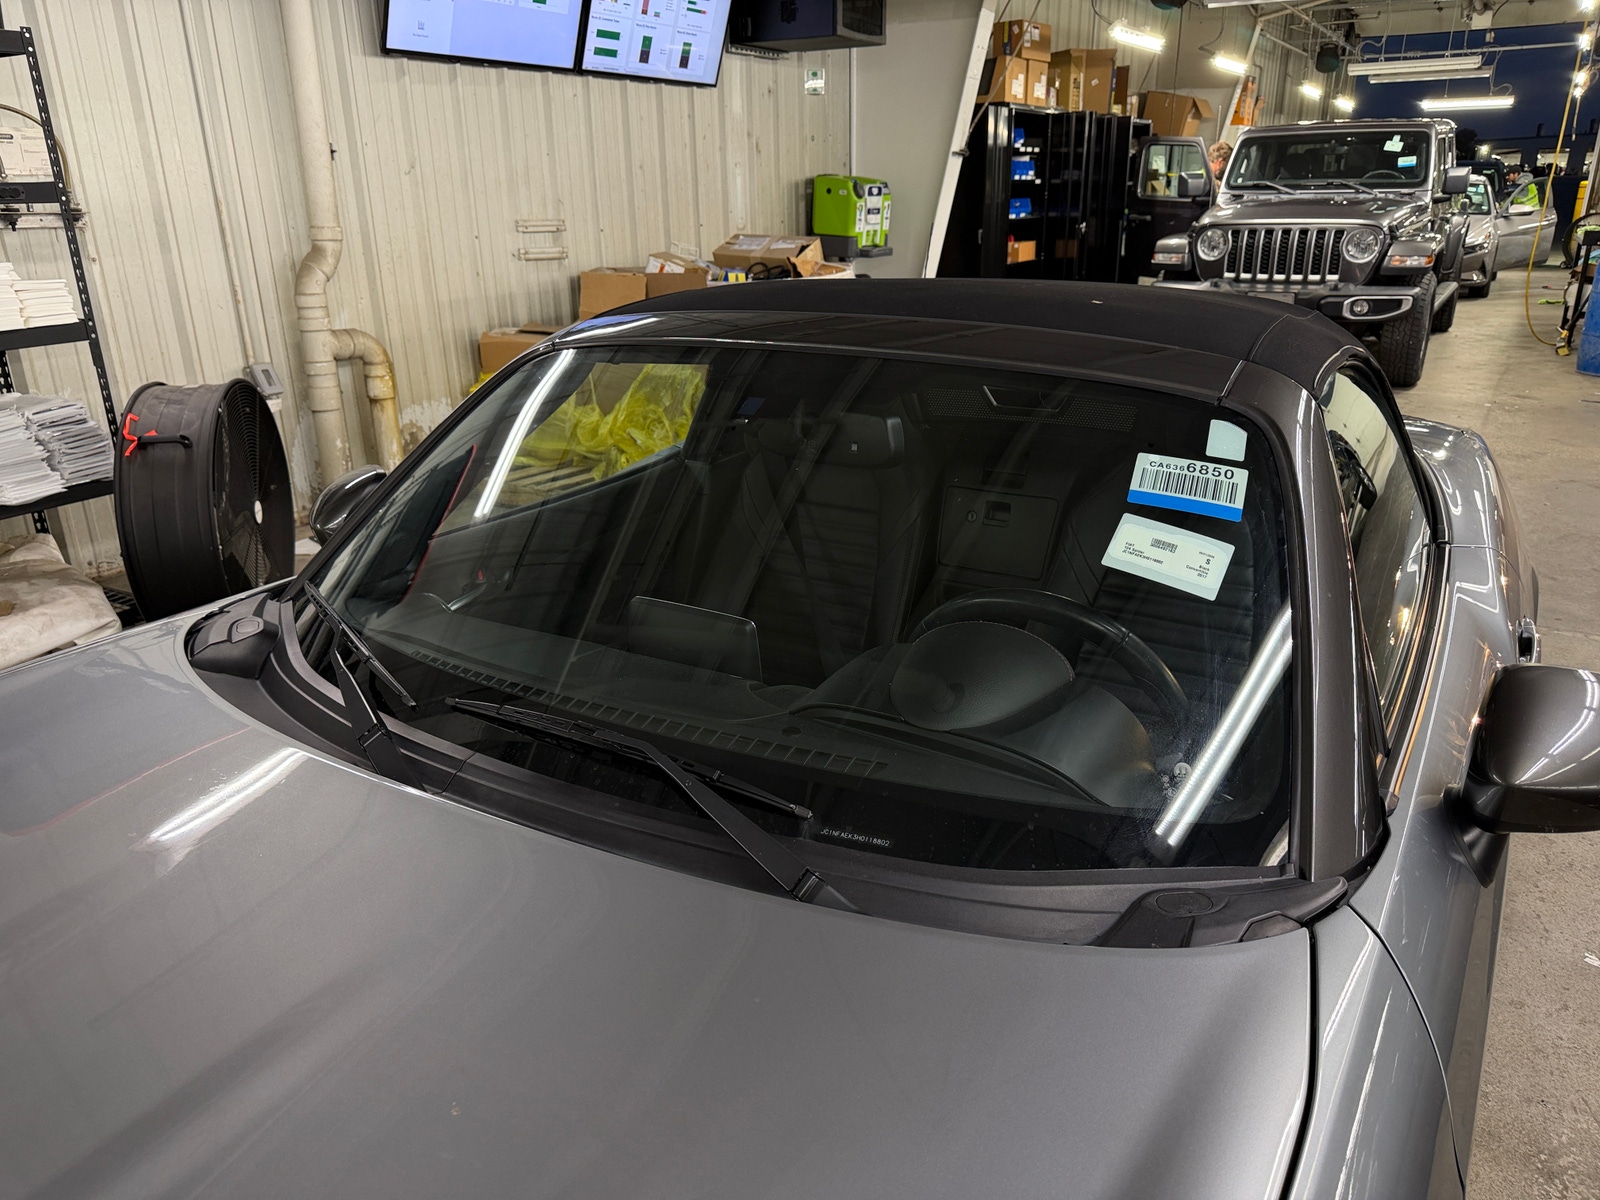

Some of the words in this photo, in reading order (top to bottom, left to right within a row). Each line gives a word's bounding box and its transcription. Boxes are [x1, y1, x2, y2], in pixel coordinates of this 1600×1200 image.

[1149, 460, 1234, 480] CA6366850
[1205, 558, 1211, 566] S
[1186, 564, 1209, 576] Convertible
[1198, 564, 1210, 572] Black
